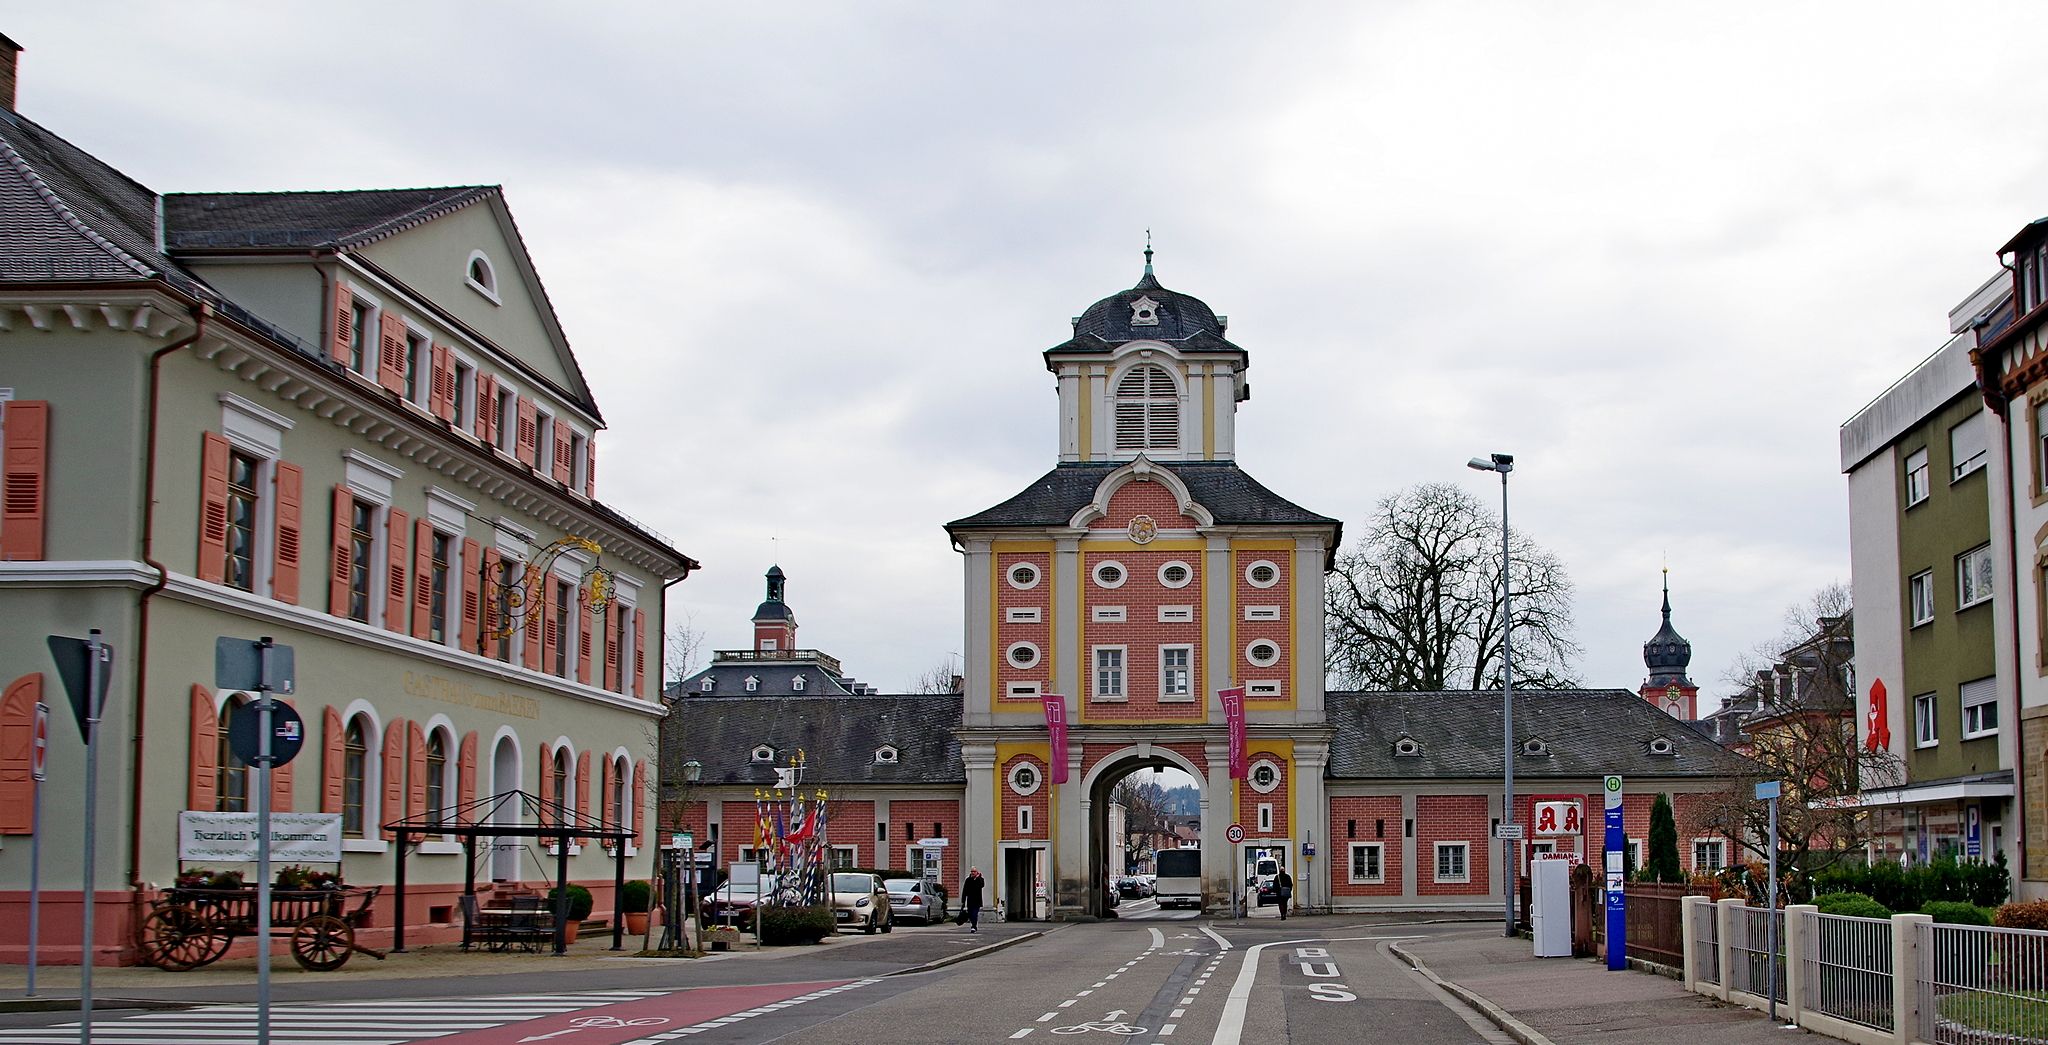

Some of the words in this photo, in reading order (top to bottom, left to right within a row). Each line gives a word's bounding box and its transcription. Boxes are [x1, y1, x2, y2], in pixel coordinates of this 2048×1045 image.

[1968, 807, 1978, 838] P
[194, 829, 247, 842] Herzlich
[250, 830, 328, 842] Wlkommen
[1229, 829, 1242, 839] 30
[1542, 852, 1578, 860] DAMIAN-
[1295, 947, 1358, 1002] BUS
